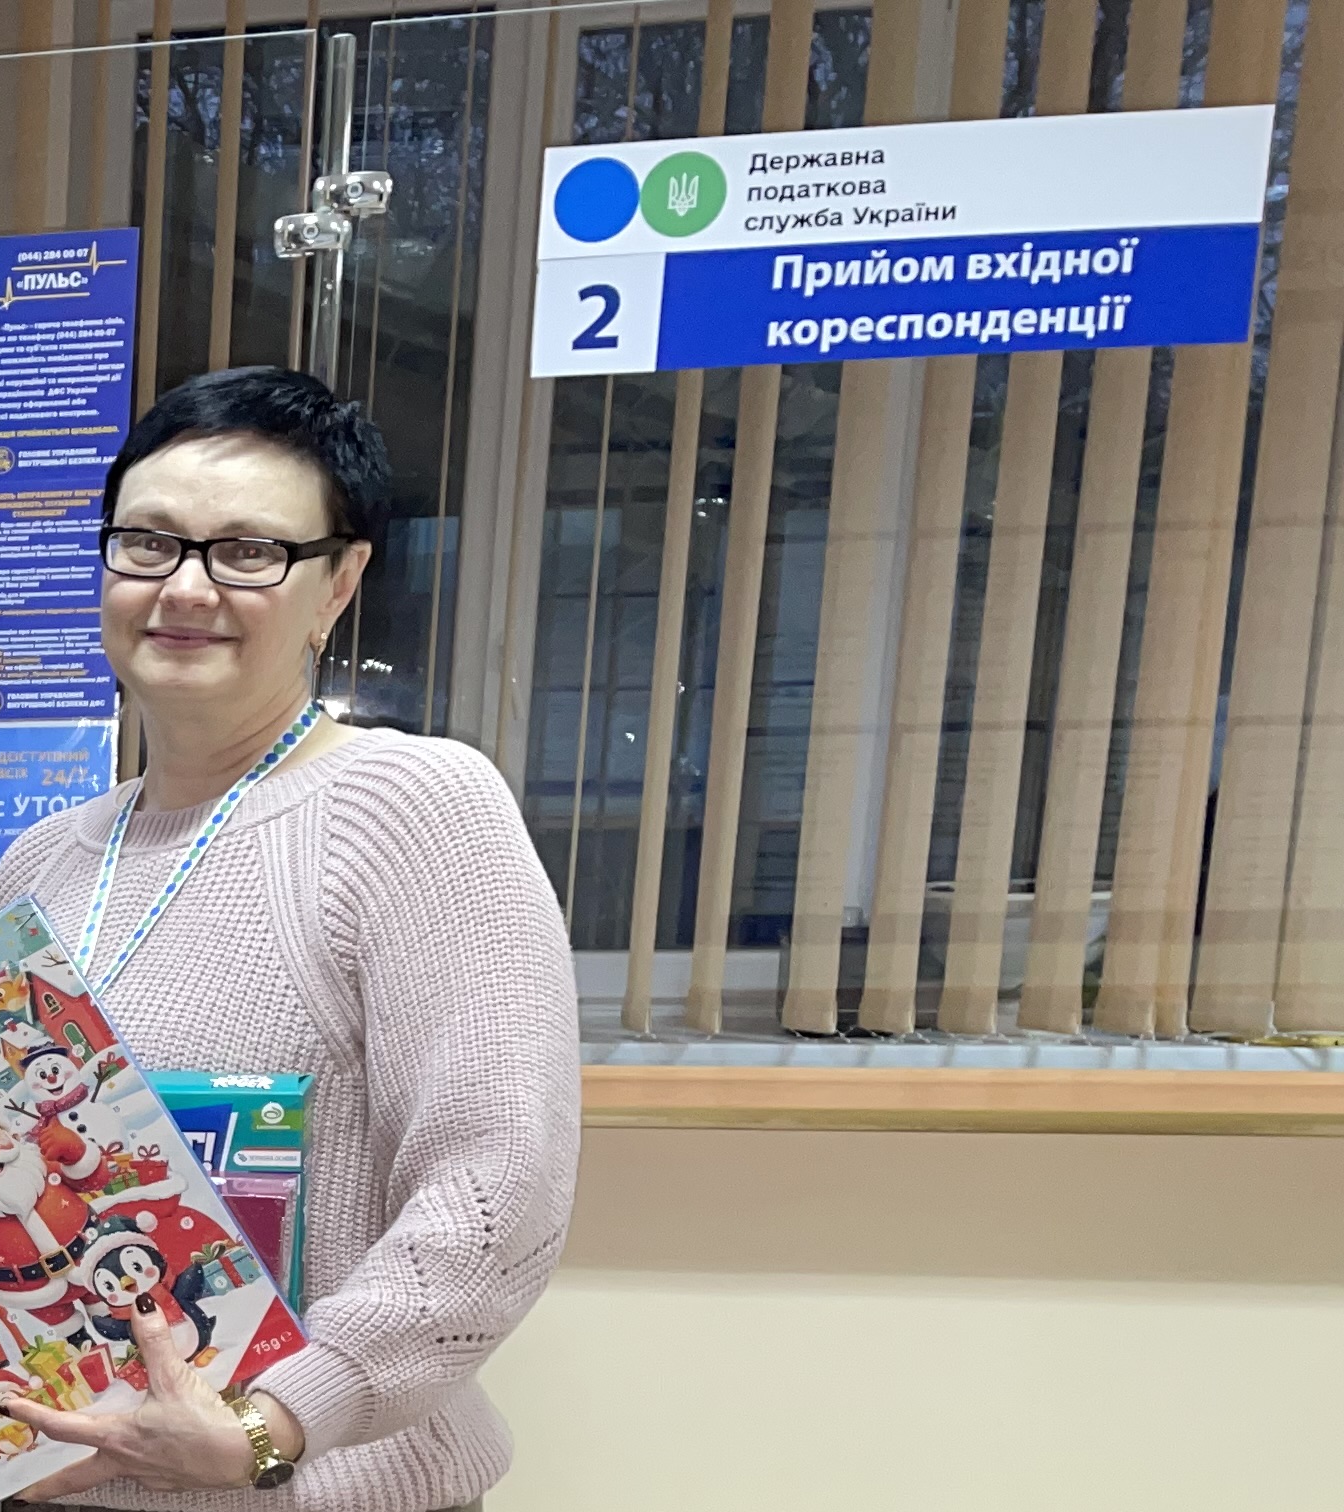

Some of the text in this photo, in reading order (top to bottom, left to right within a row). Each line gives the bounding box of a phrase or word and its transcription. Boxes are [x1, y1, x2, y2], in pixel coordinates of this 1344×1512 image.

[749, 149, 885, 175] Державна
[747, 178, 886, 202] податкова
[744, 202, 958, 234] служба України
[771, 236, 1140, 297] Прийом вхідної
[571, 284, 622, 351] 2
[766, 294, 1132, 353] кореспонденції
